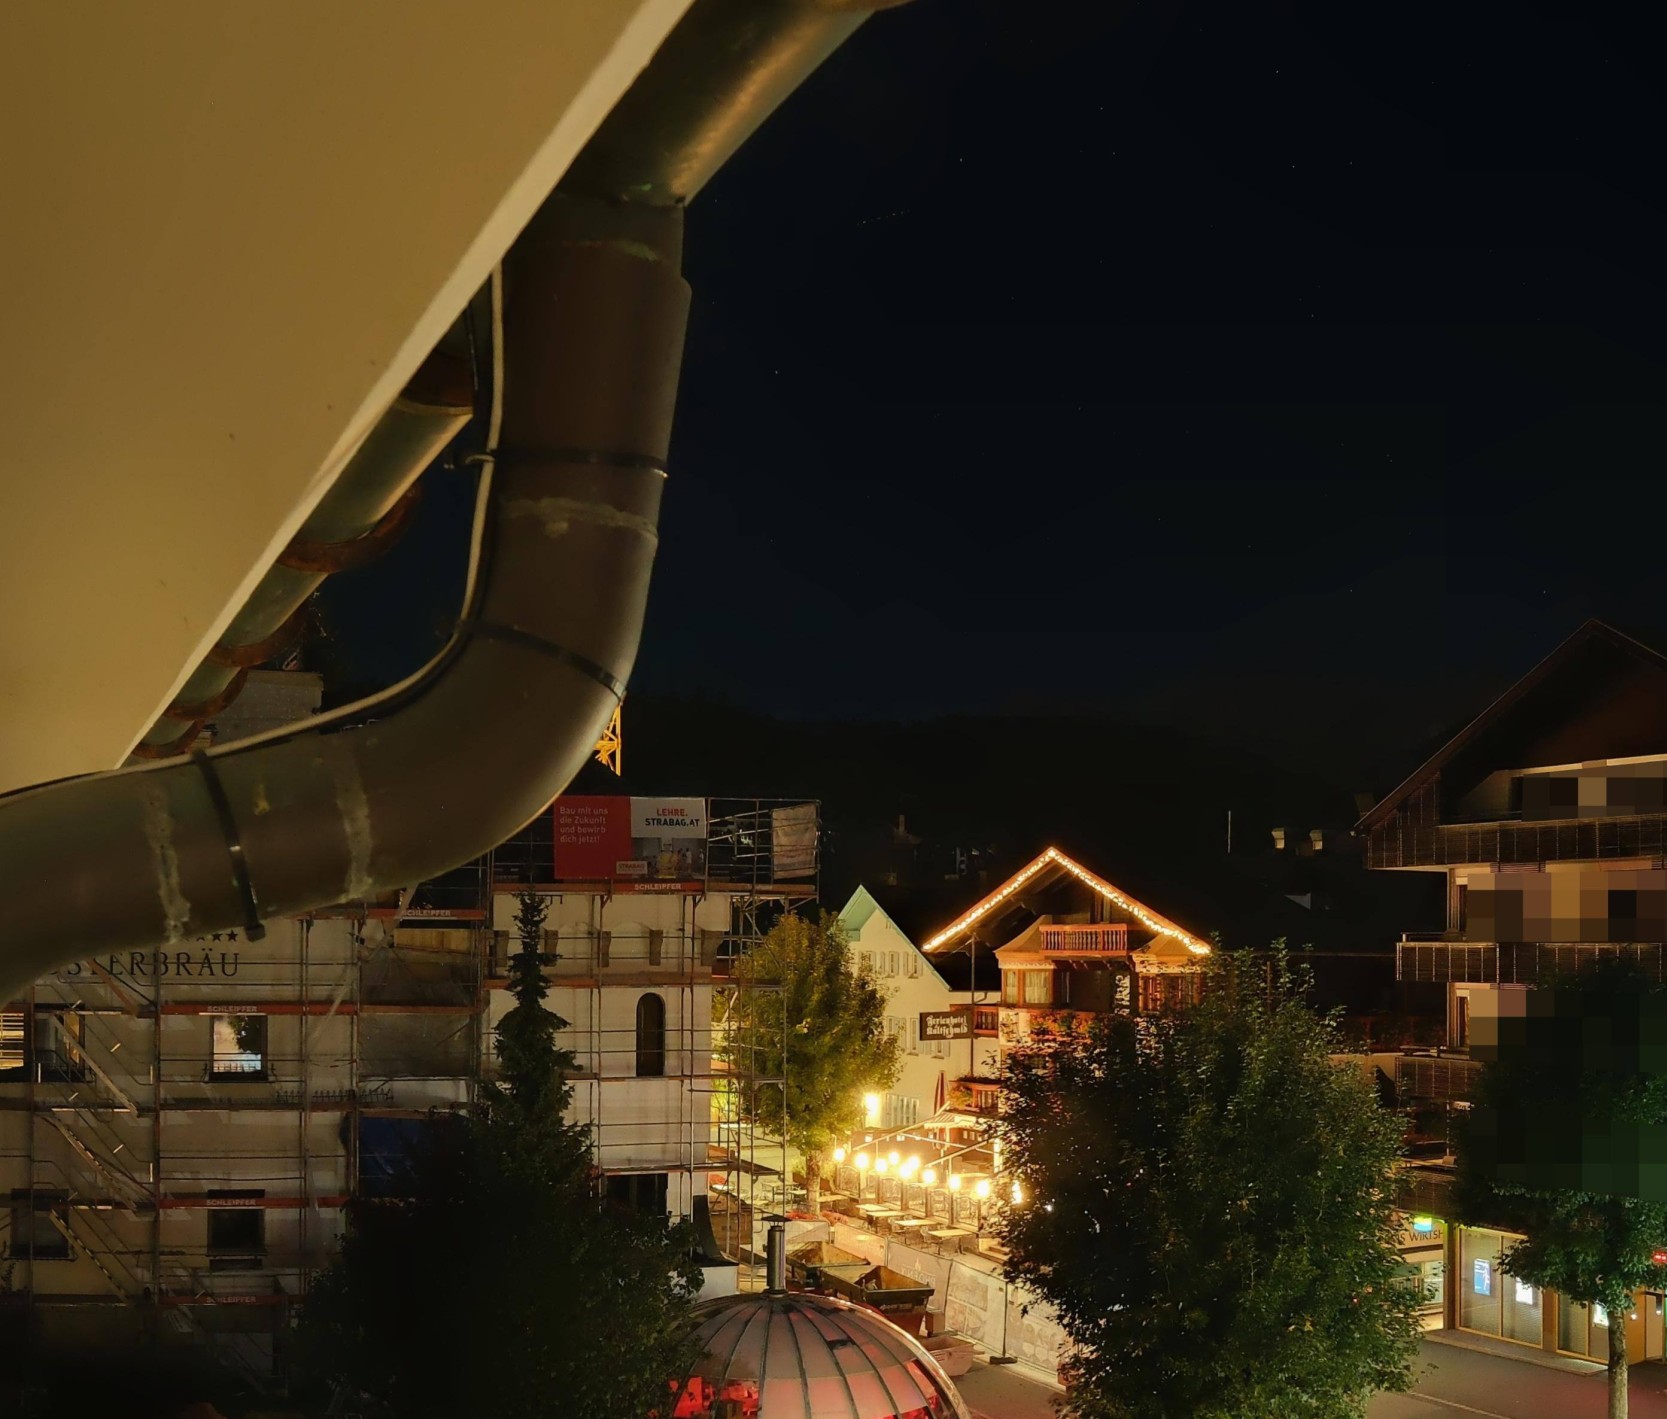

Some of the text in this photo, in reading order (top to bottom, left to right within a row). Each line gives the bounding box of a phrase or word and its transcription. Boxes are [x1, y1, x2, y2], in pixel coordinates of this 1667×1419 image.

[656, 808, 689, 817] LEHRE.
[645, 818, 700, 827] STRABAG.AT
[634, 883, 682, 891] SCHLEIPFER
